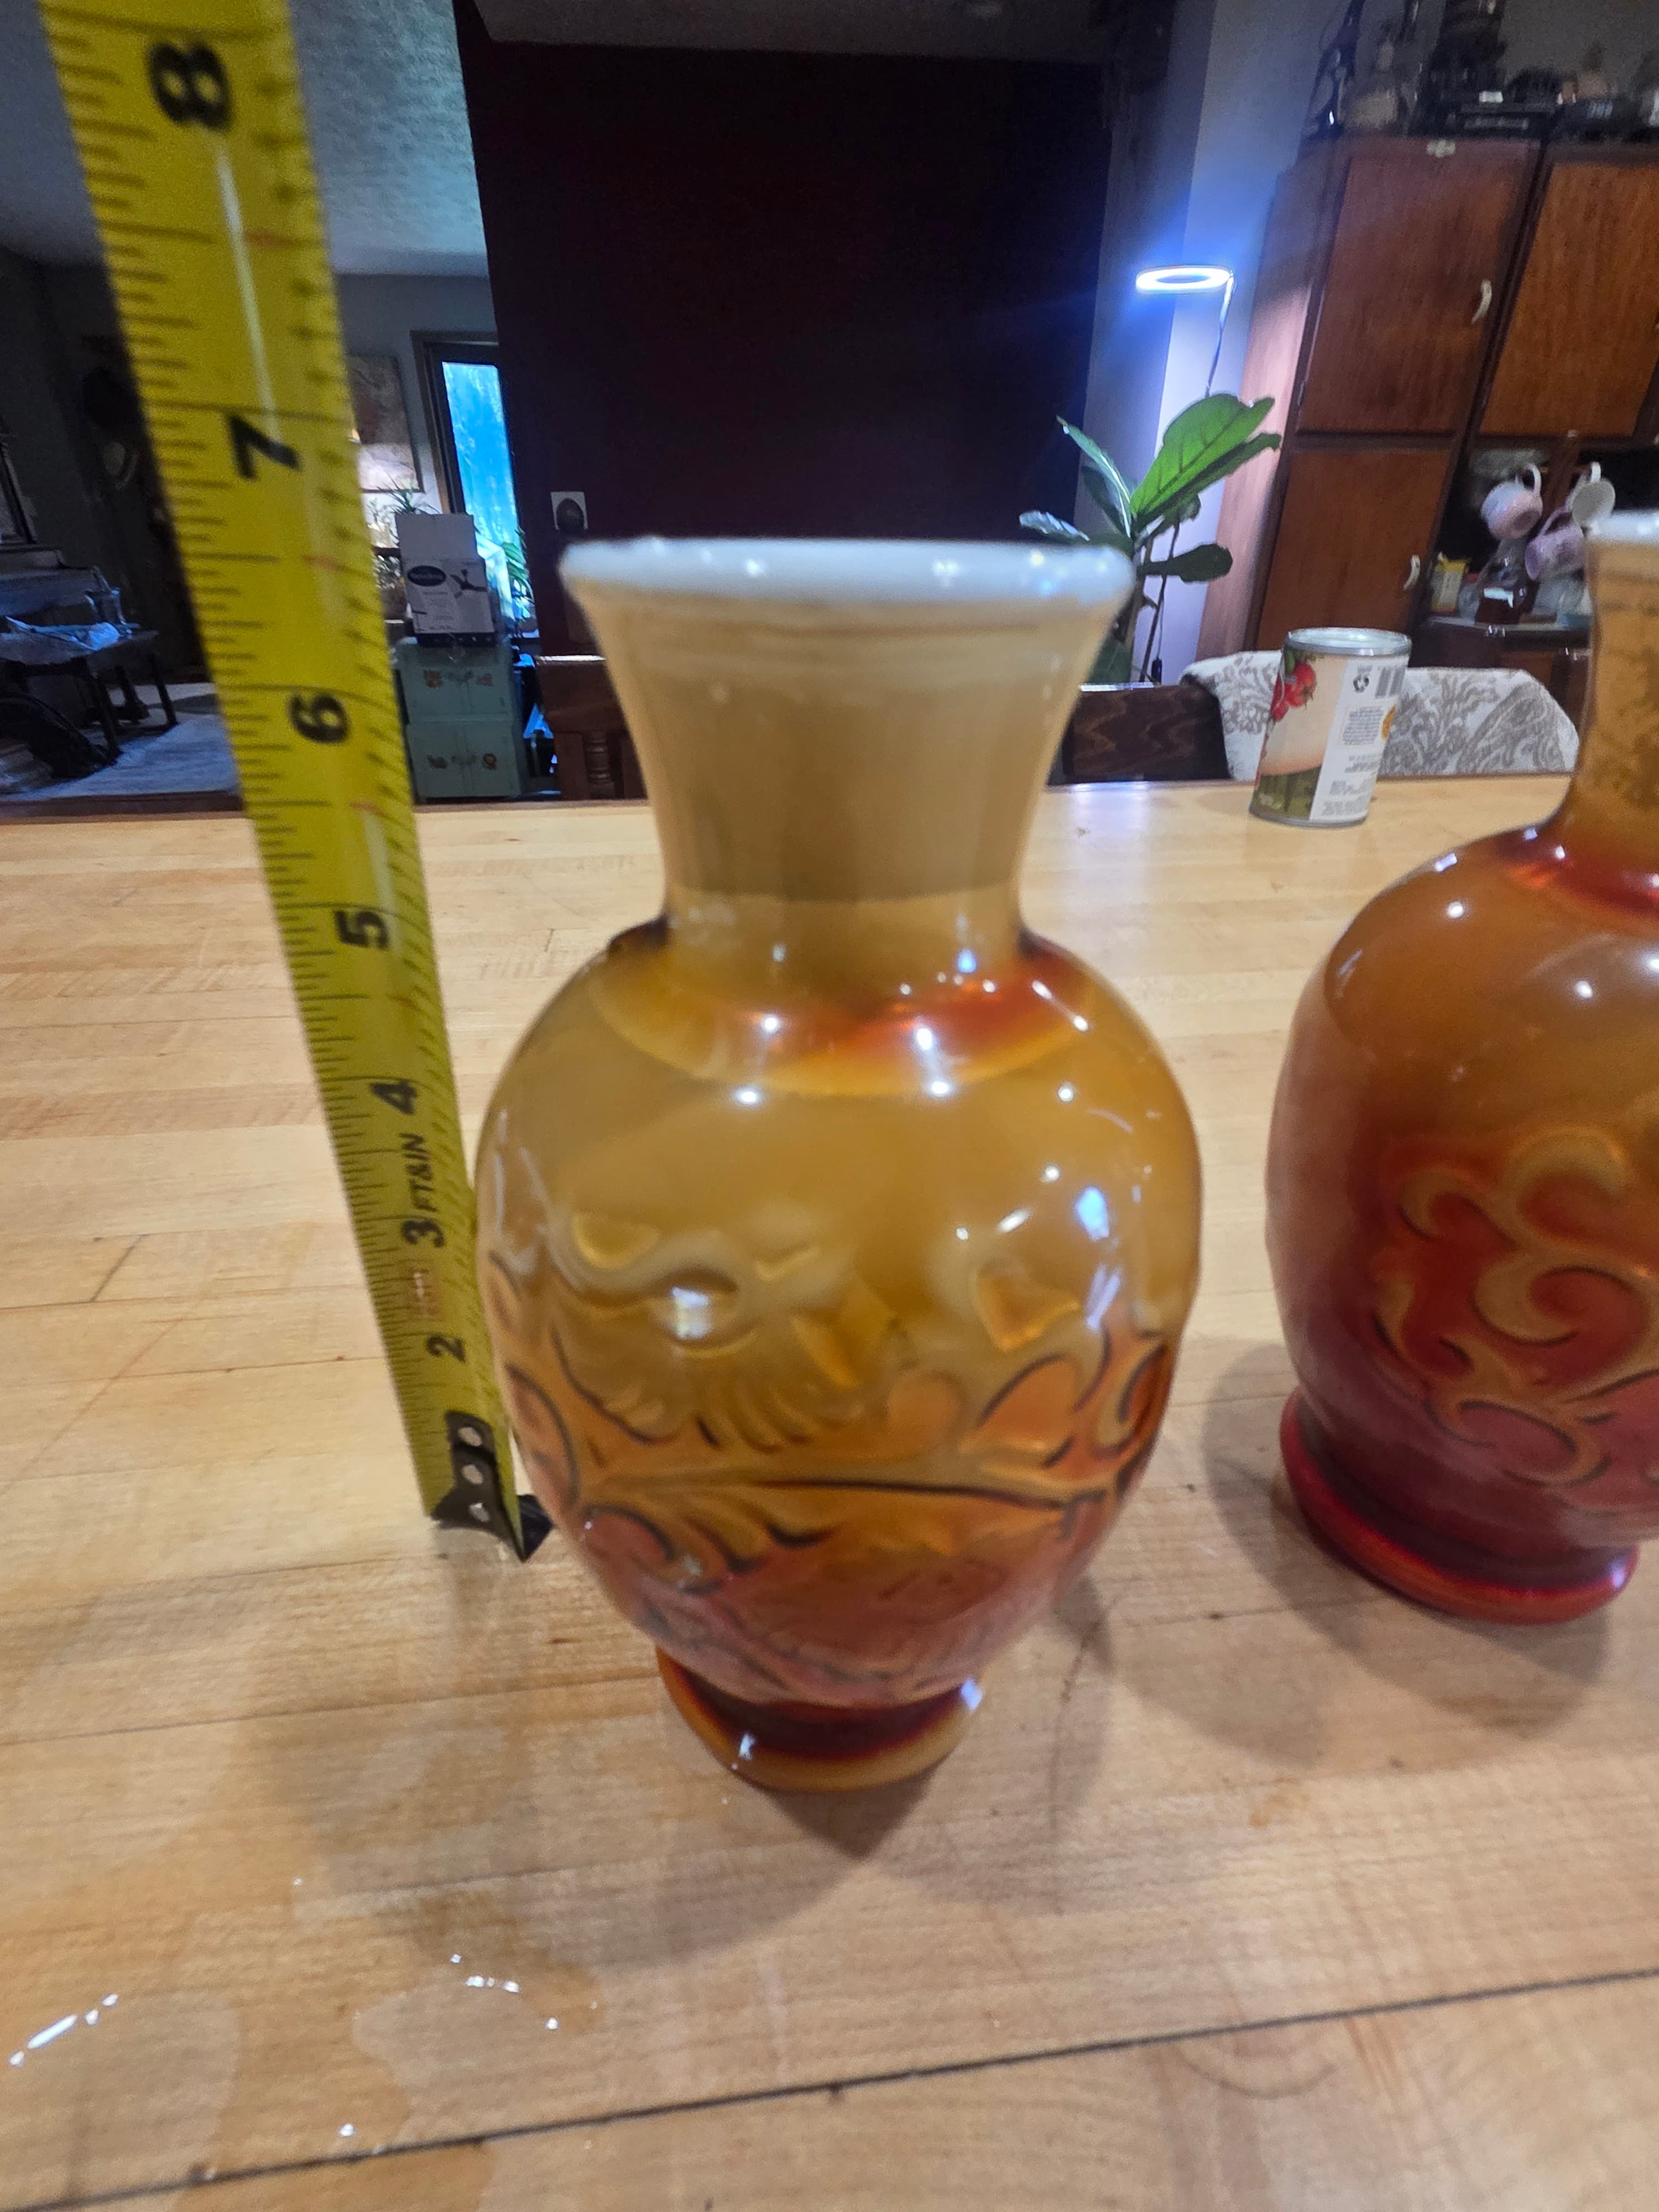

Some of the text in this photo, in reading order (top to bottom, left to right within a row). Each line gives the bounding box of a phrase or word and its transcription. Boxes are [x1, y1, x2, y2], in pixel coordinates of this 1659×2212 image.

[146, 40, 236, 134] 8
[227, 411, 302, 481] 7
[286, 693, 351, 745] 6
[333, 910, 390, 952] 5
[369, 1079, 418, 1115] 4
[400, 1219, 445, 1248] 3
[425, 1334, 466, 1363] 2
